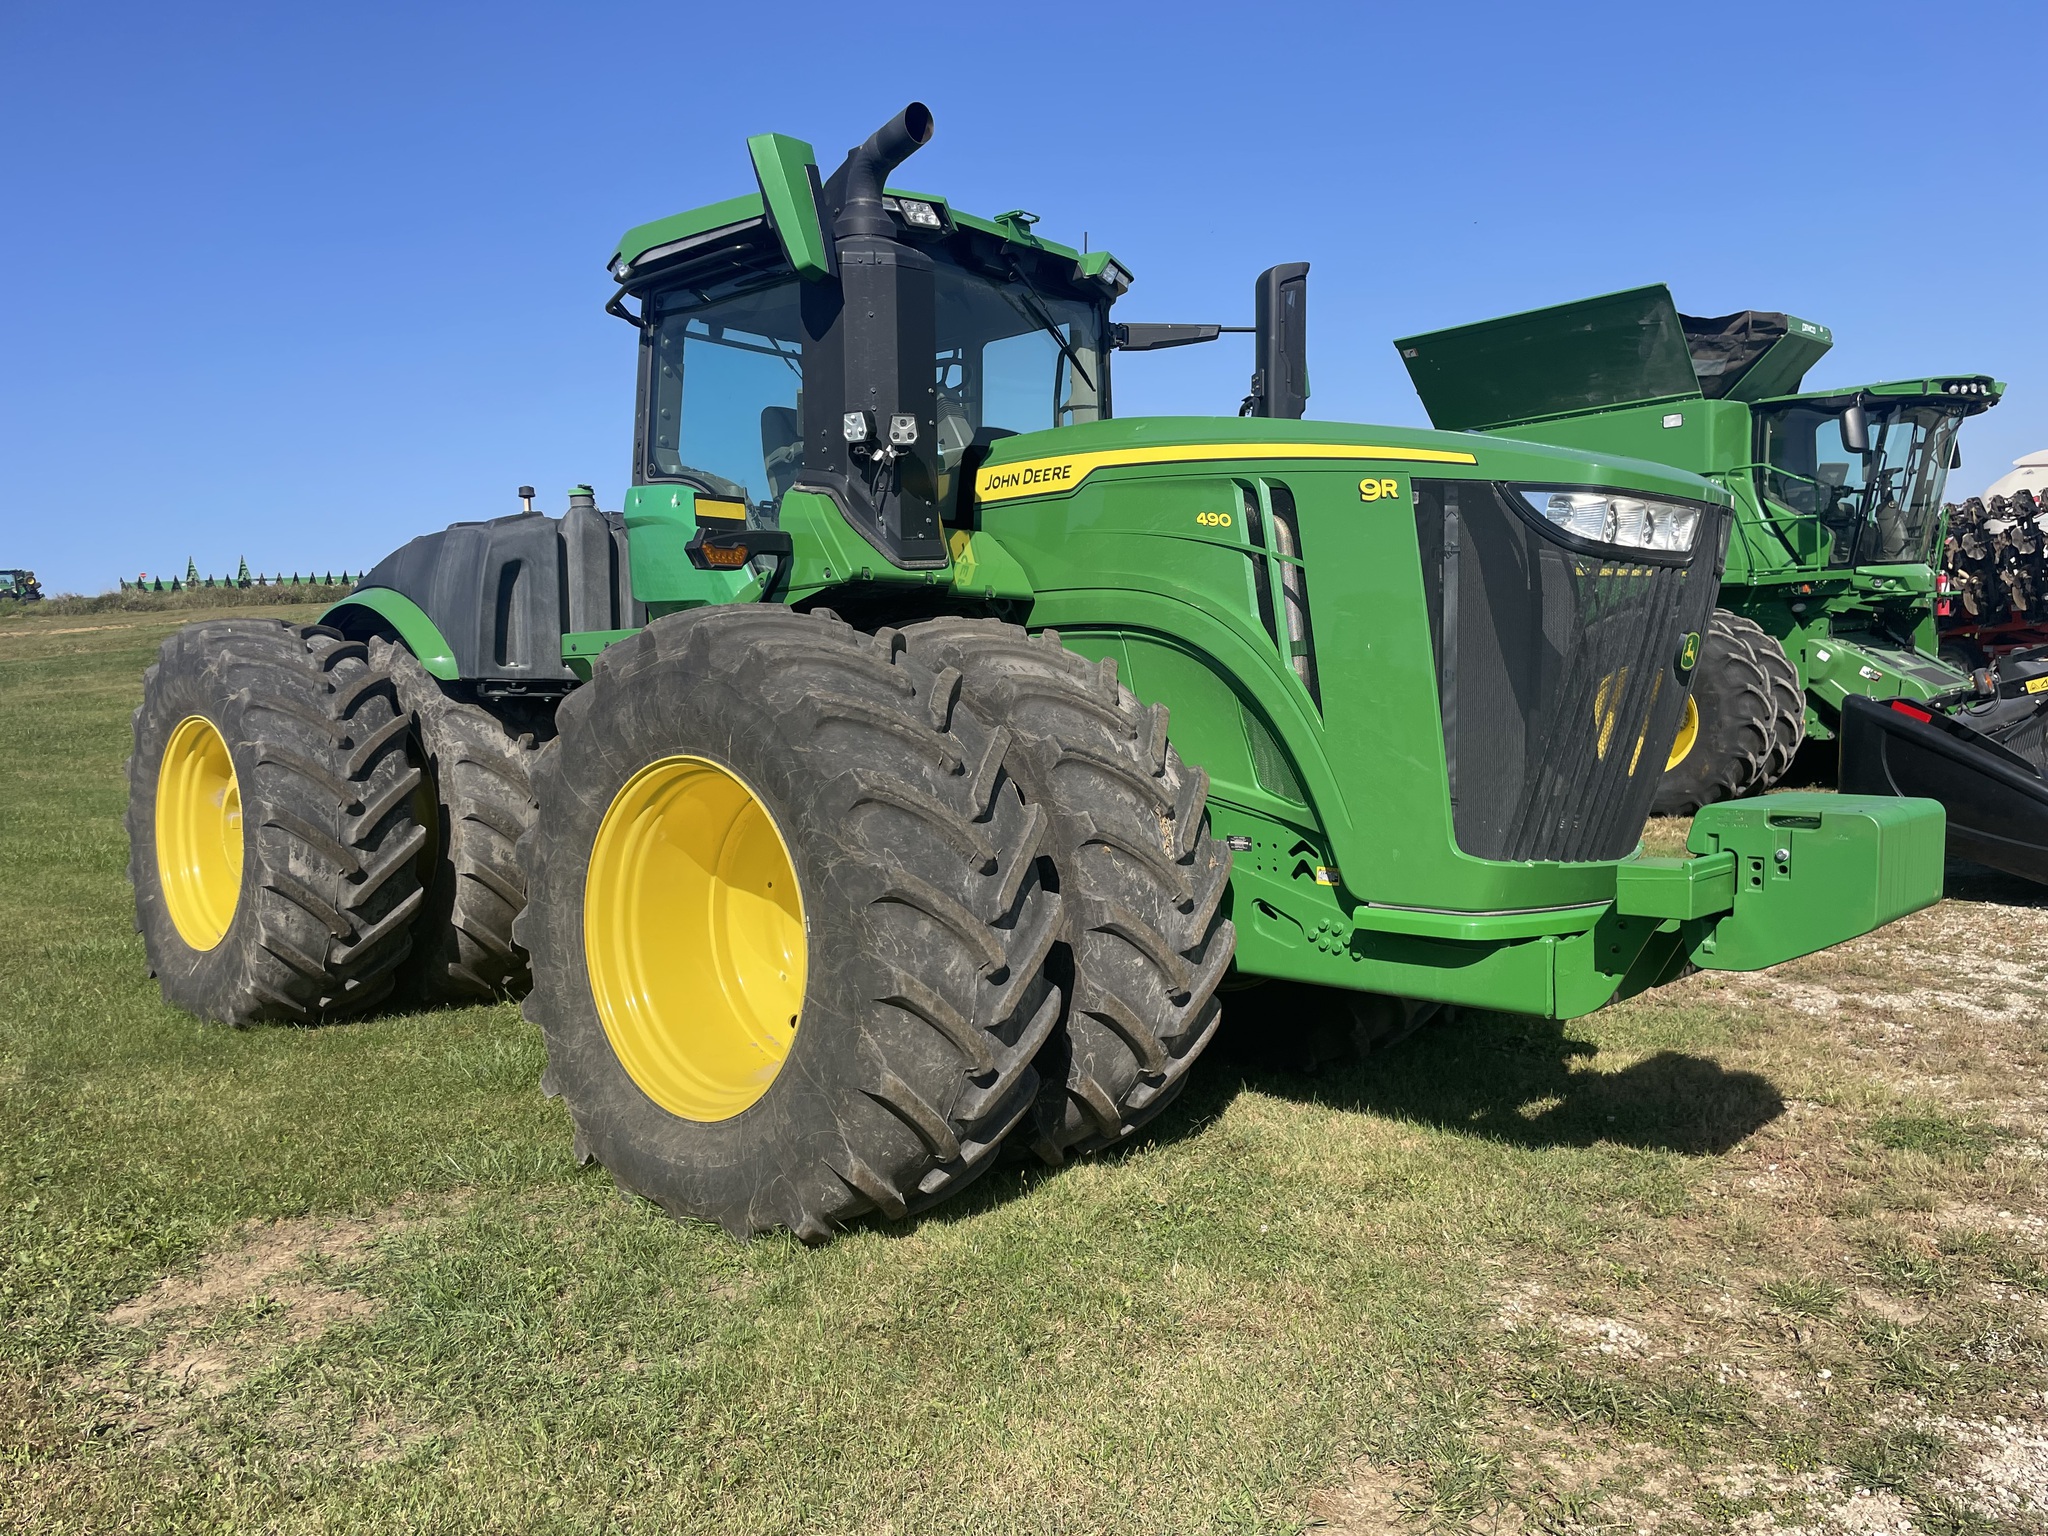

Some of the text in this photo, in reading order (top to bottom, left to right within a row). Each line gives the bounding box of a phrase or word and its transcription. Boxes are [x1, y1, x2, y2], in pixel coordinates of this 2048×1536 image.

[984, 464, 1072, 491] JOHN DEERE
[1358, 478, 1399, 502] 9R
[1196, 512, 1232, 528] 490
